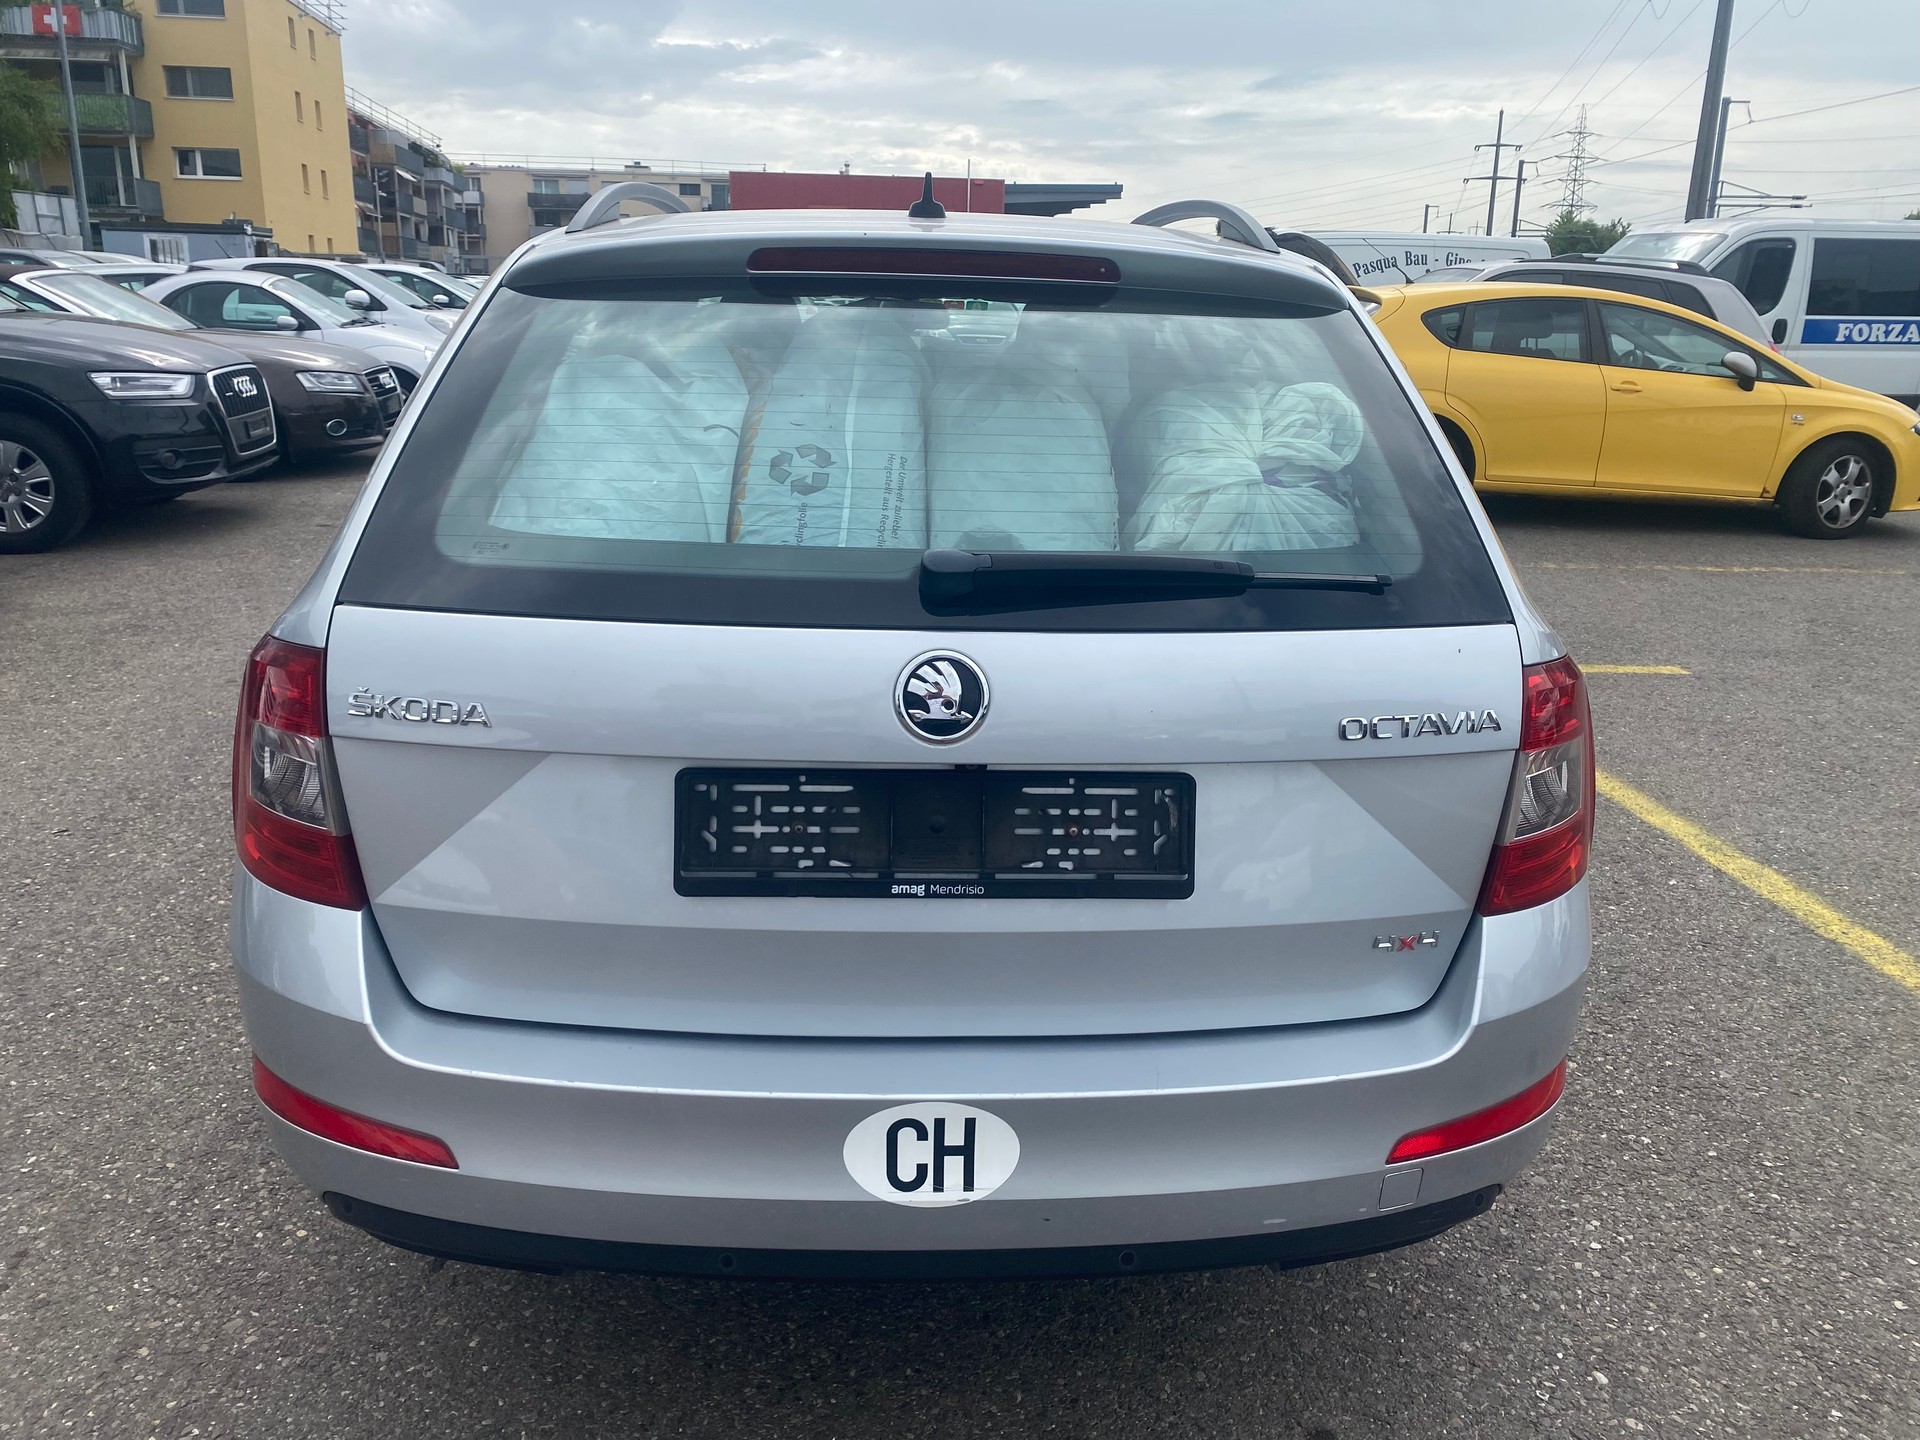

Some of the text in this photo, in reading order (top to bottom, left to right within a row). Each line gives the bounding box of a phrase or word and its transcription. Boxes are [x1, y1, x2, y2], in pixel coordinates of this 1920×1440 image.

[1352, 256, 1397, 278] Pasqua
[1404, 250, 1428, 266] Bau
[1835, 323, 1920, 342] FORZA
[883, 453, 896, 495] Hergestellt
[898, 455, 908, 470] Der
[895, 471, 907, 503] Umwelt
[881, 496, 890, 511] aus
[347, 686, 492, 728] ŠKODA
[1338, 708, 1502, 741] OCTAVIA
[891, 884, 985, 896] amag Mendrisio
[886, 1117, 977, 1193] CH
